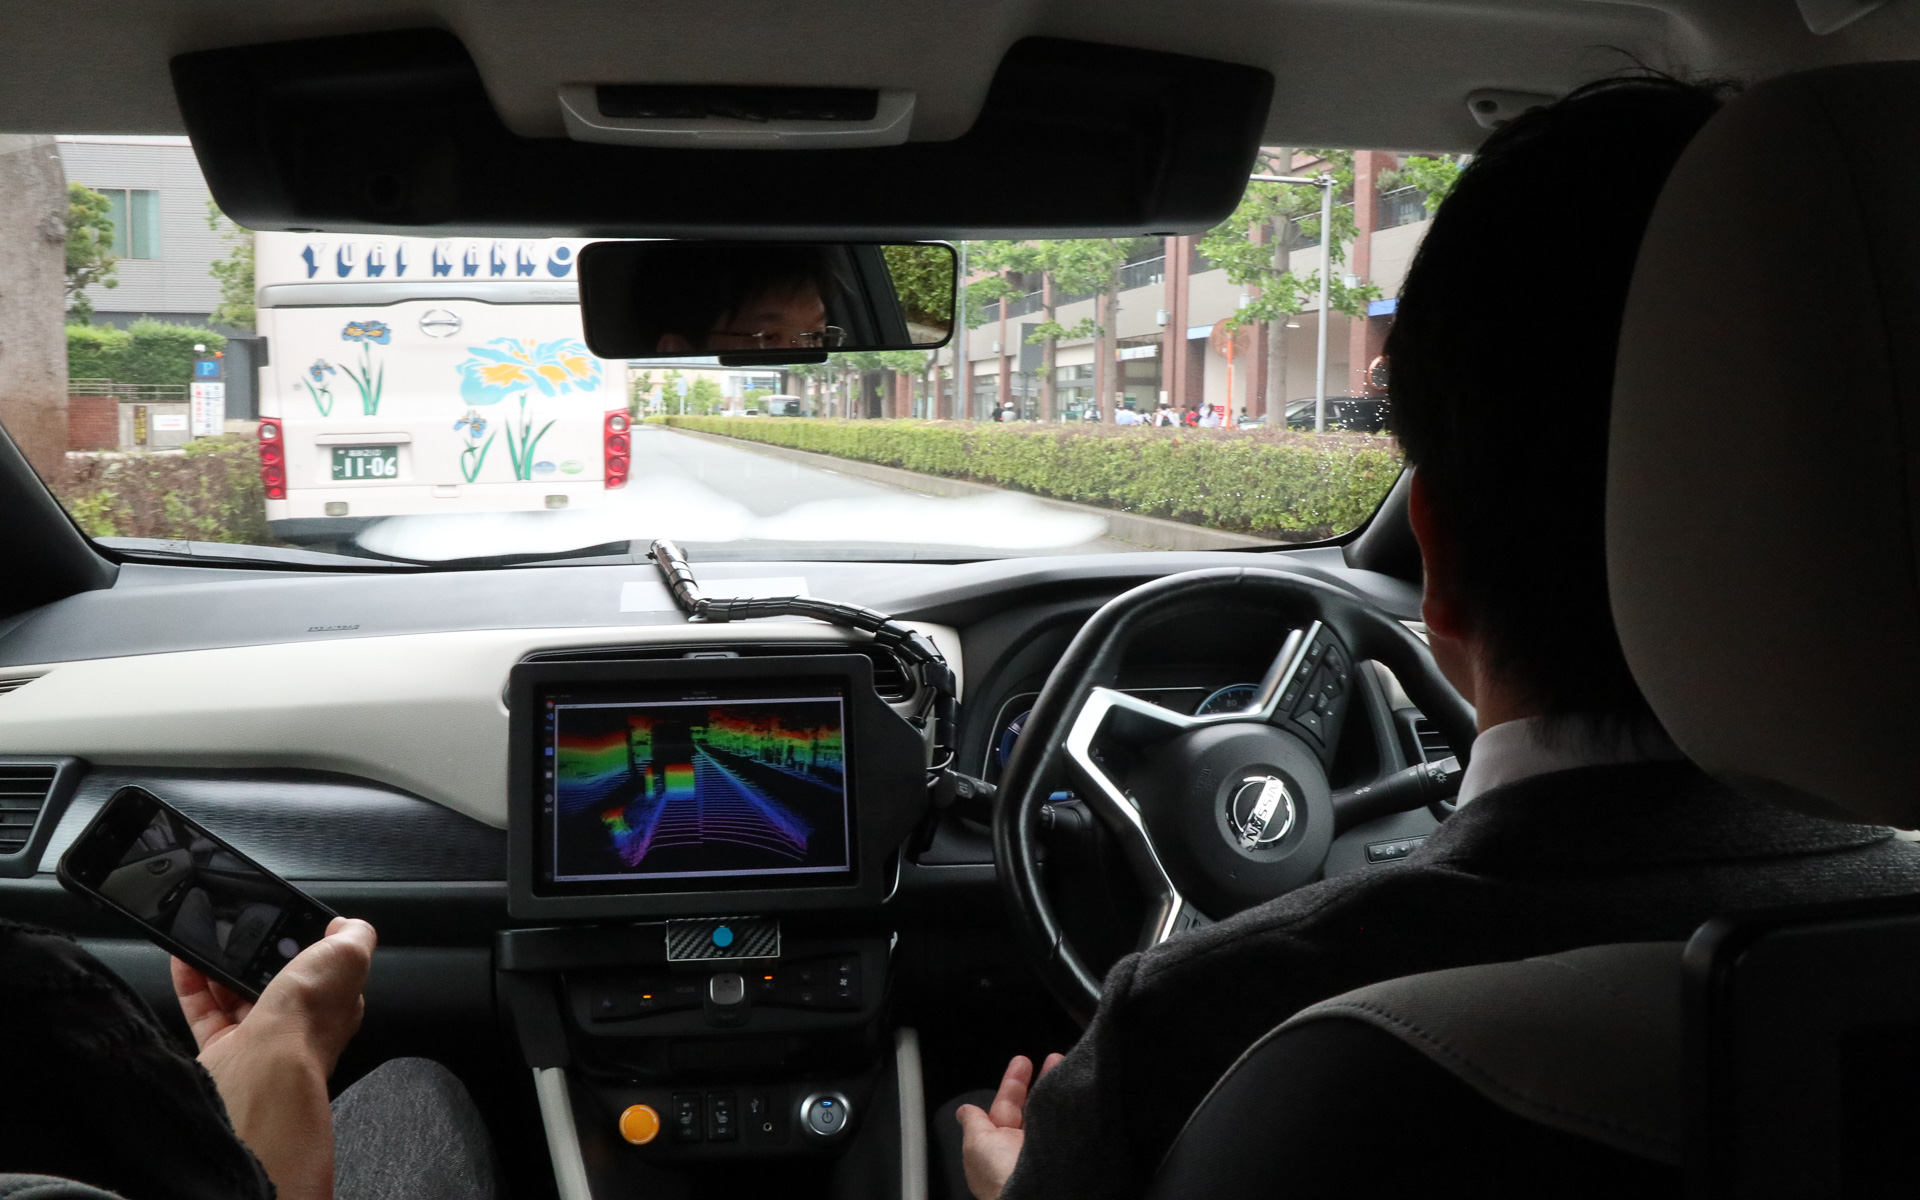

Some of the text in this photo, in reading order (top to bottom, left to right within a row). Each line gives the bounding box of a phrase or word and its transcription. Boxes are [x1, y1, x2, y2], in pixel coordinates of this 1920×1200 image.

[302, 241, 574, 279] YUAI KANKO
[201, 362, 215, 376] P
[344, 456, 397, 477] 11-06
[1226, 699, 1238, 707] 80
[1243, 782, 1280, 843] NISSAN
